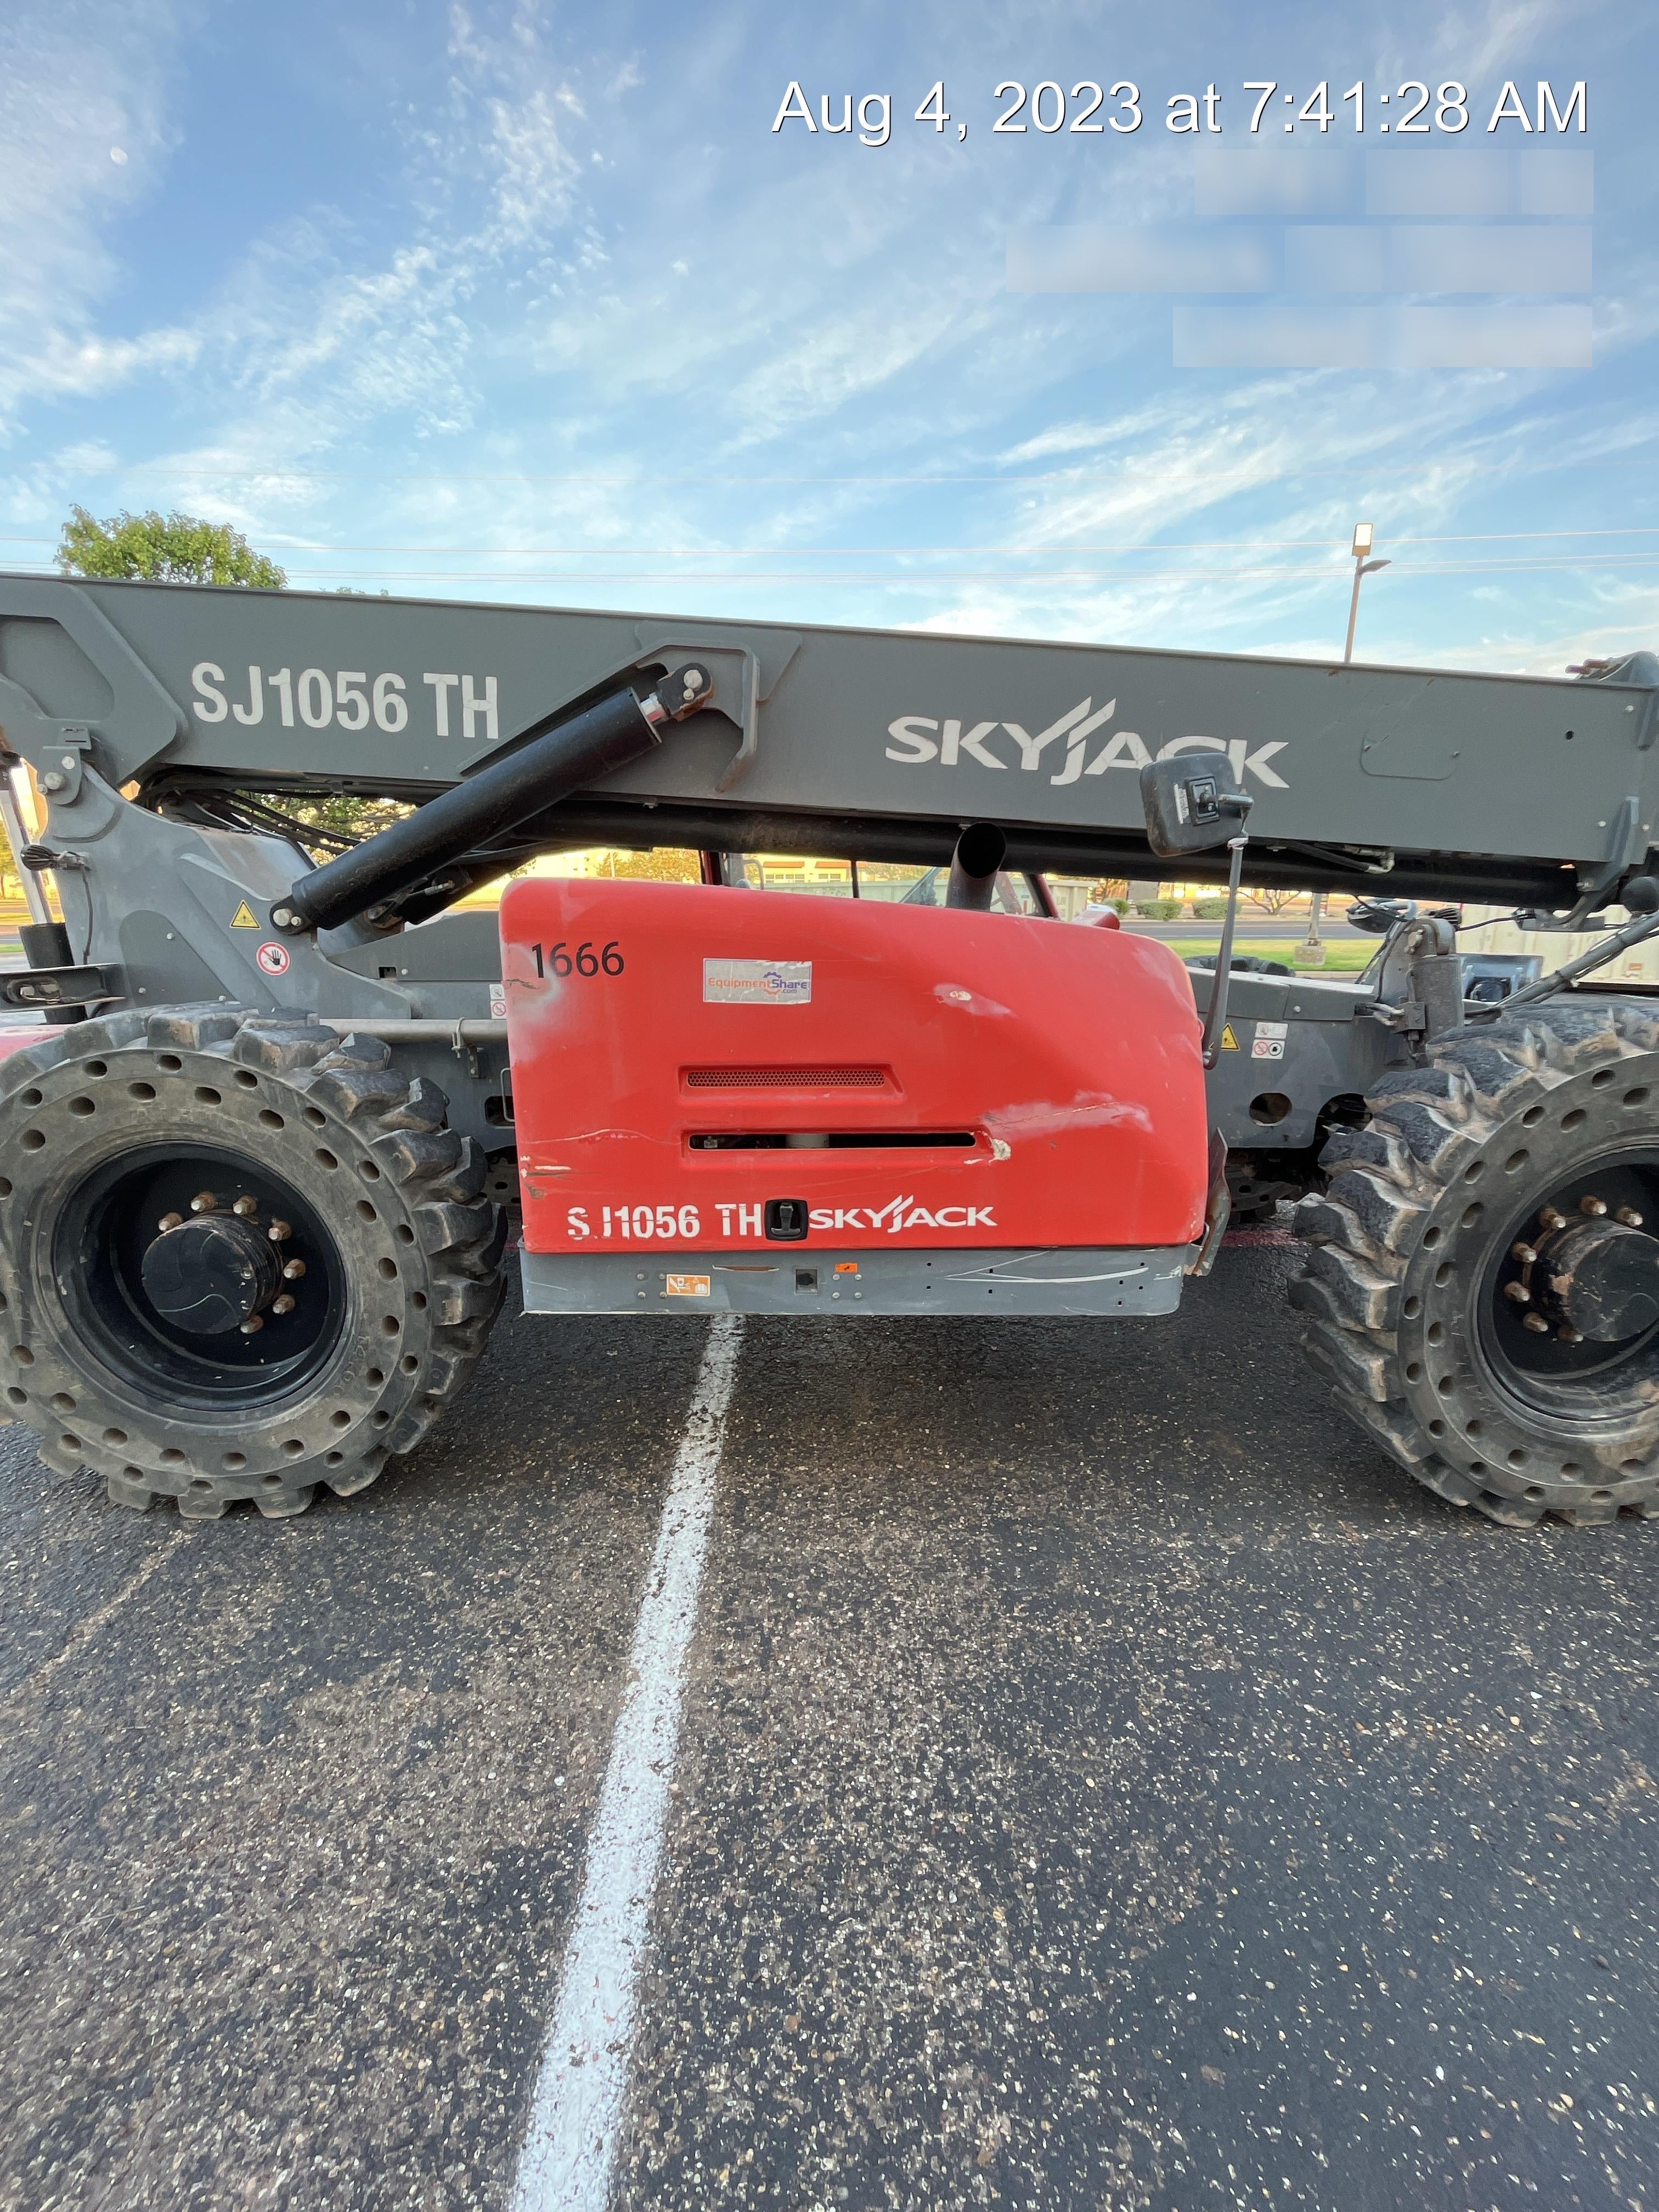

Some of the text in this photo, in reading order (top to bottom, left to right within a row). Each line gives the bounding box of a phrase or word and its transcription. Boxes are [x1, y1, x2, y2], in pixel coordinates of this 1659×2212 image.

[192, 662, 499, 739] SJ1056 TH
[532, 941, 624, 978] 1666
[708, 977, 807, 989] EquipmentShare
[714, 1203, 763, 1237] TH
[808, 1194, 998, 1233] SKYJACK
